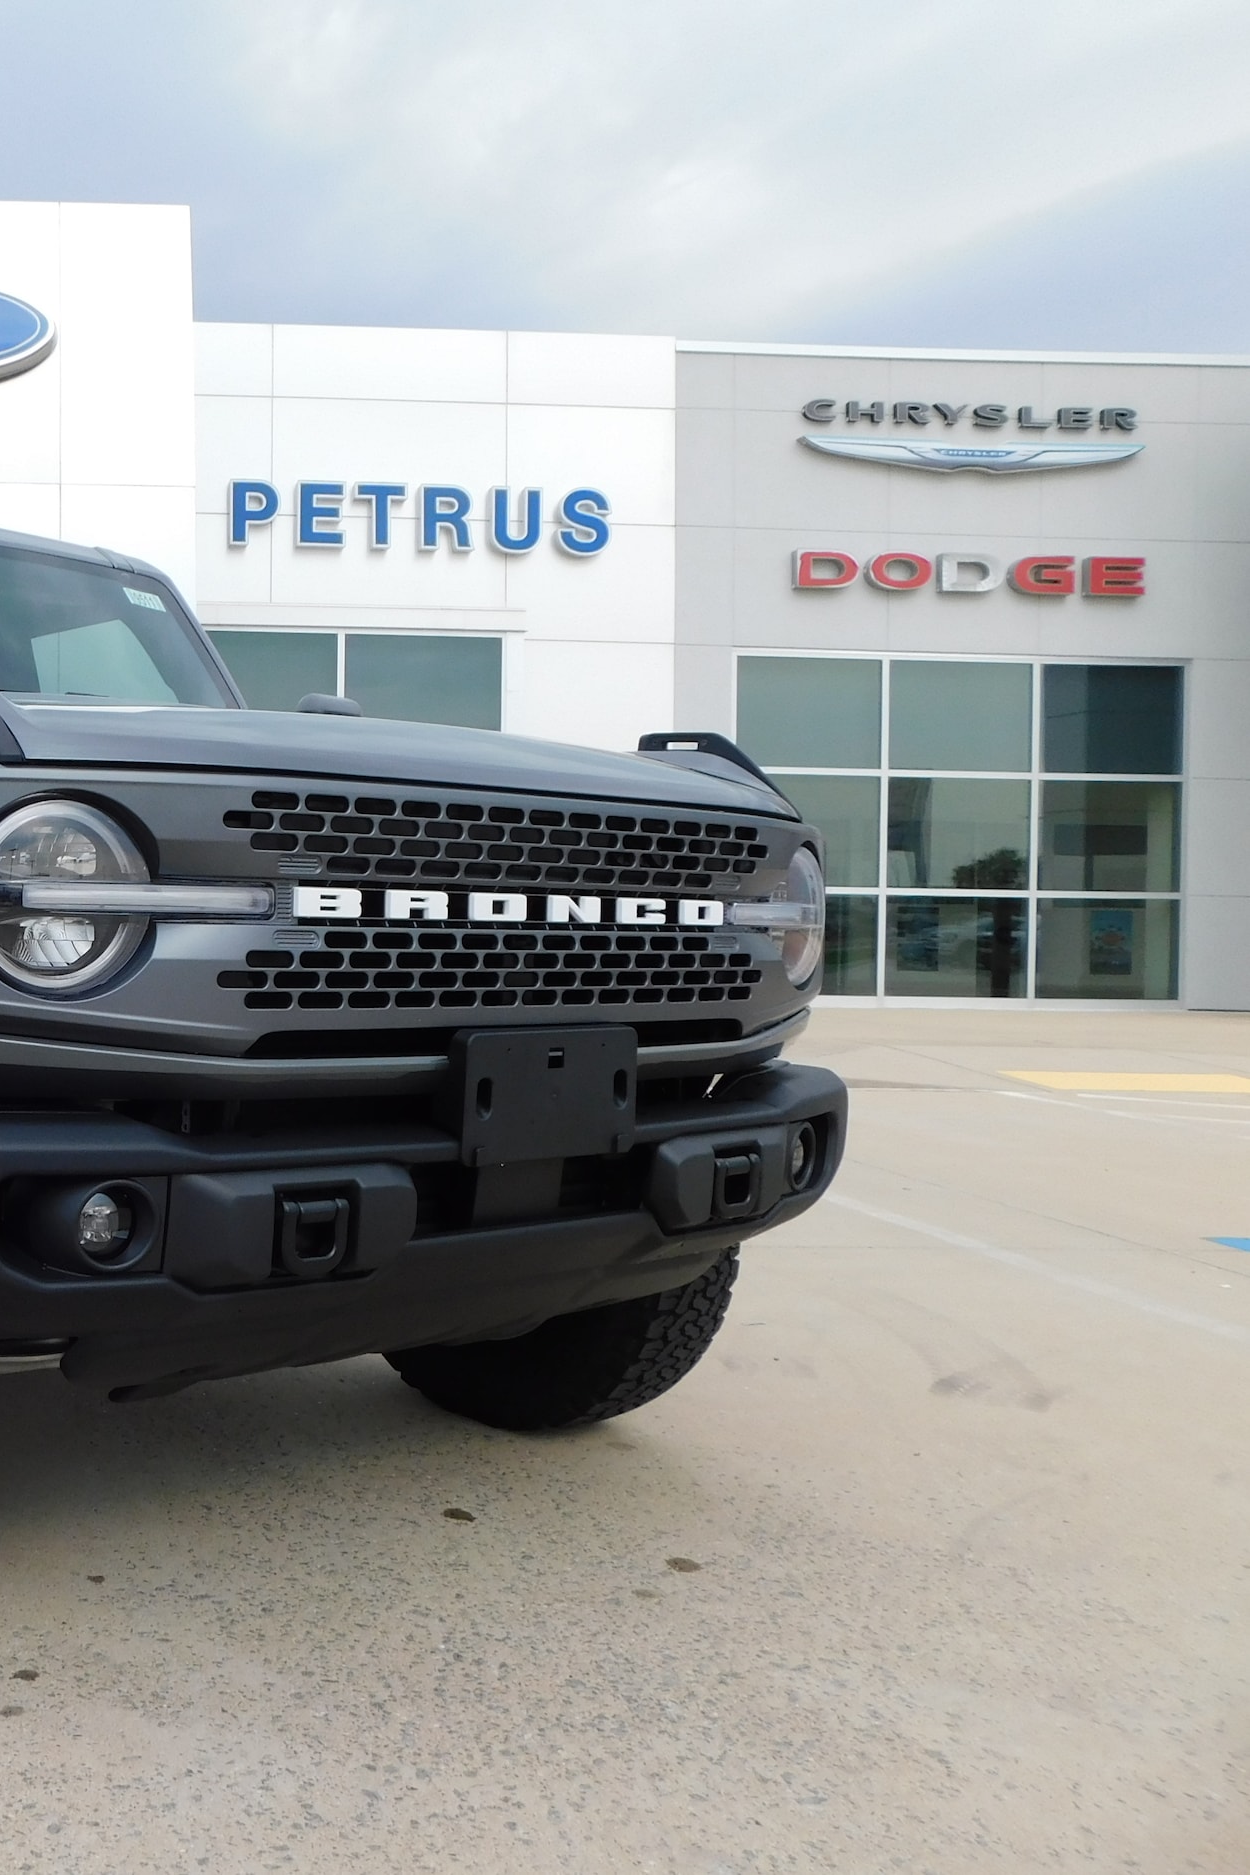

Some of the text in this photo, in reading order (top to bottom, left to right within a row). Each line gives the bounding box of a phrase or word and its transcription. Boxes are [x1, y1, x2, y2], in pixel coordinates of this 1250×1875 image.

[801, 399, 1139, 431] CHRYSLER
[228, 478, 612, 557] PETRUS
[792, 548, 1146, 599] DODGE
[293, 886, 724, 926] BRONCO
